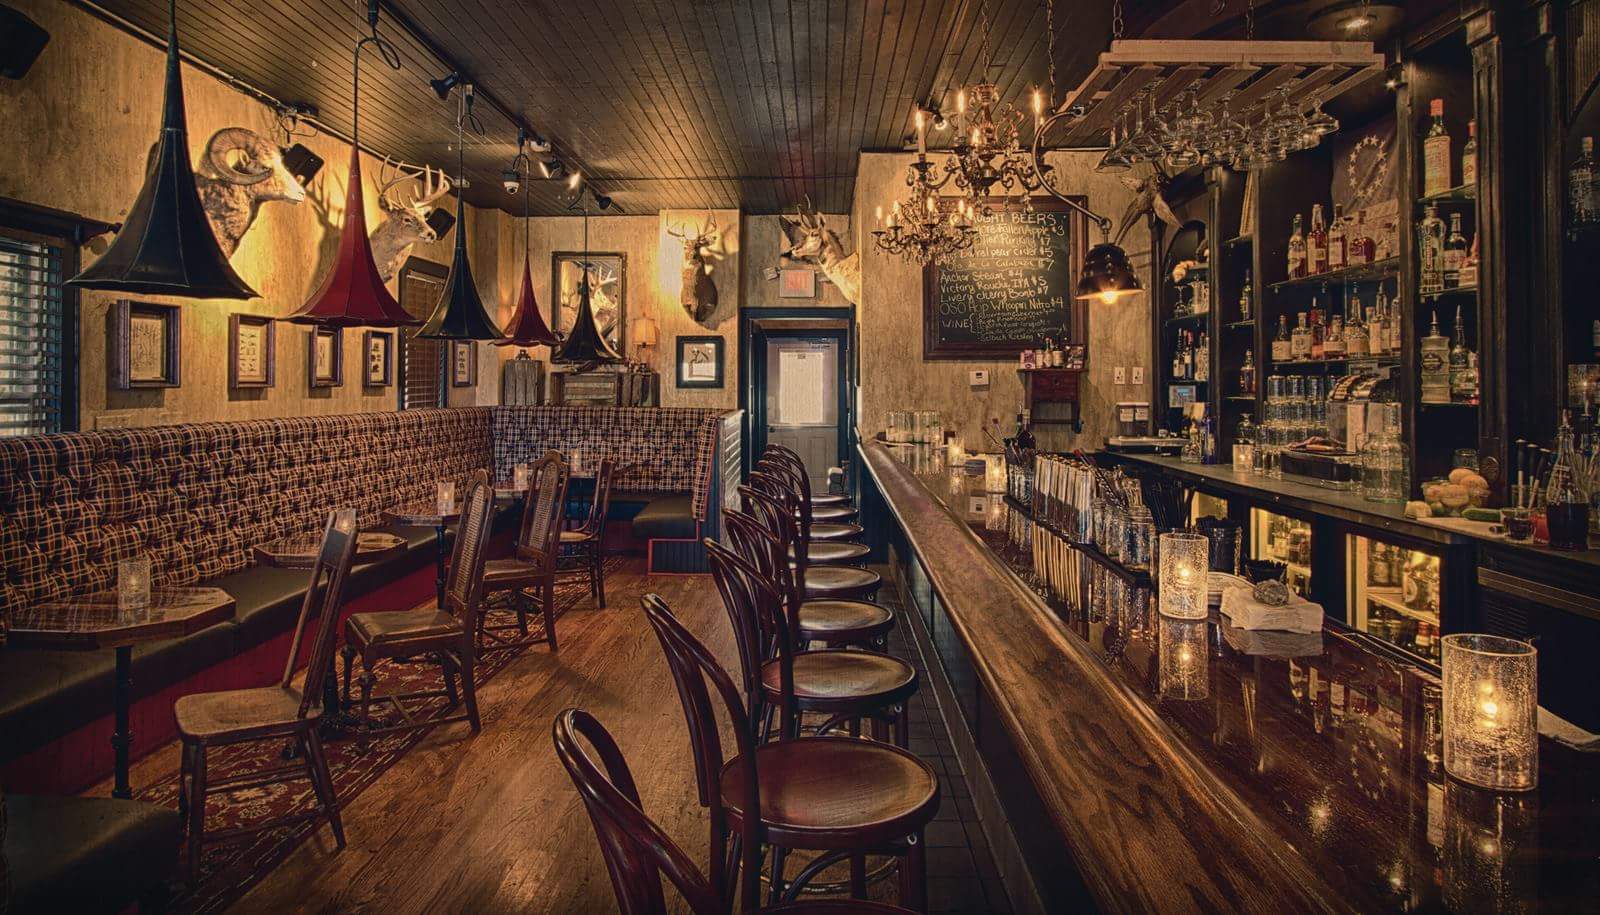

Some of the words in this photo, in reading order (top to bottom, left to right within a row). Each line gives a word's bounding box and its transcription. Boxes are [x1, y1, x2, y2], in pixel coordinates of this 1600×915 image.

[1011, 213, 1058, 226] BEERS
[940, 271, 969, 284] Anchor
[941, 319, 970, 329] WINE
